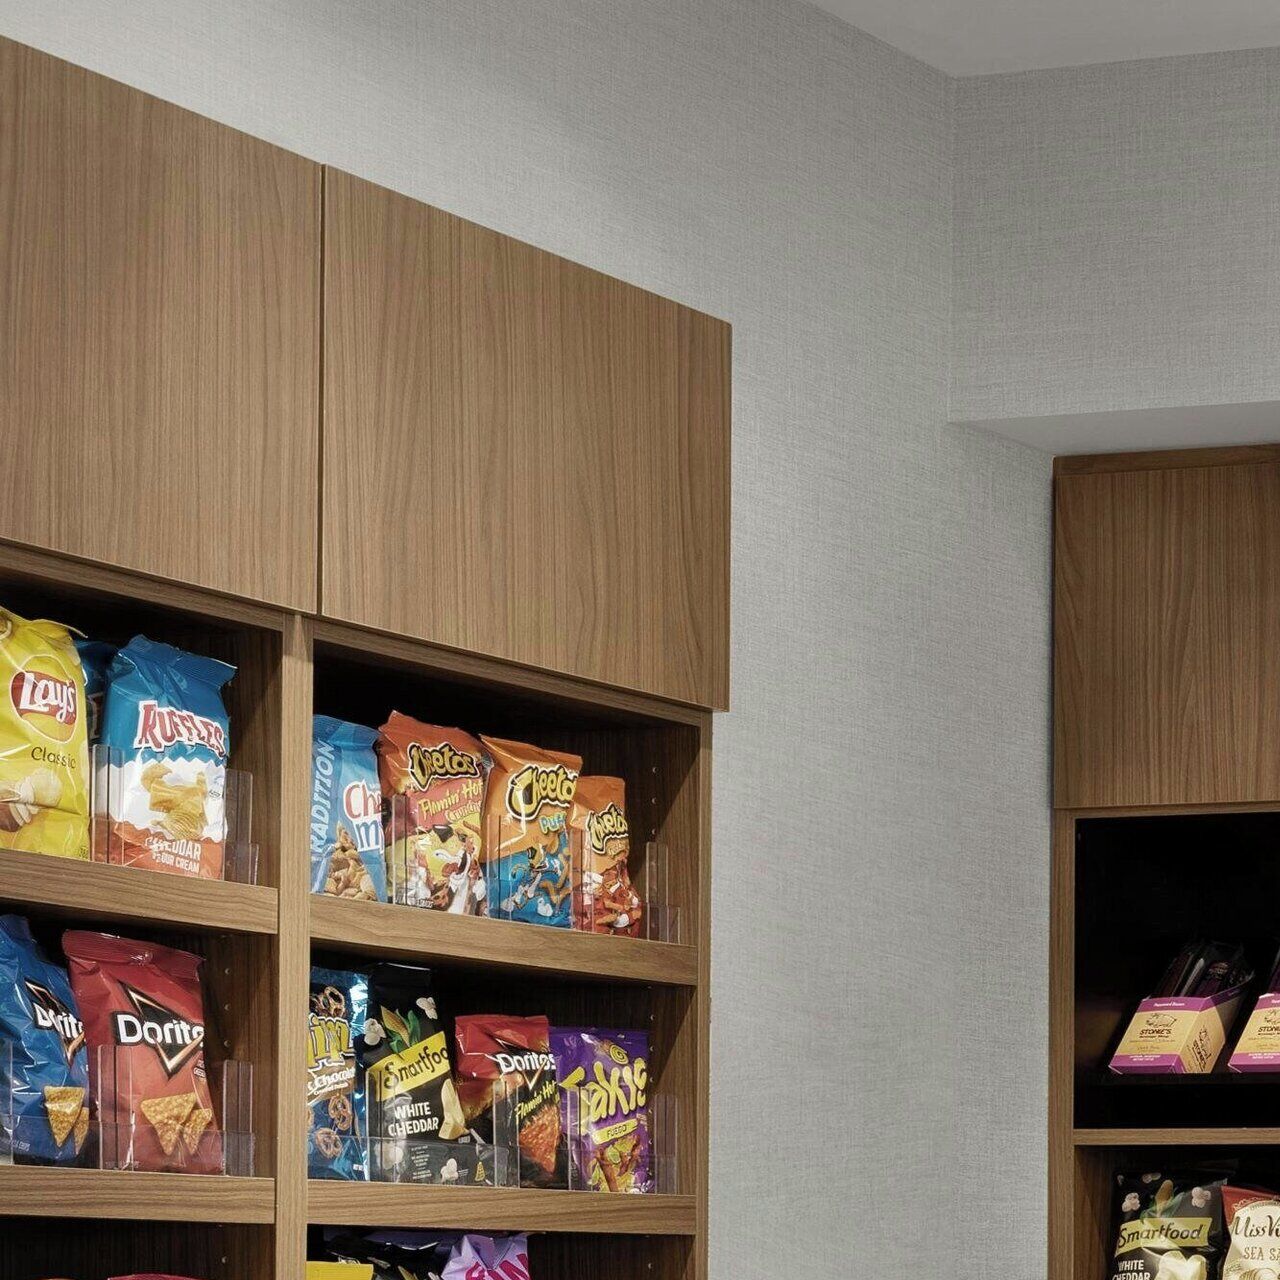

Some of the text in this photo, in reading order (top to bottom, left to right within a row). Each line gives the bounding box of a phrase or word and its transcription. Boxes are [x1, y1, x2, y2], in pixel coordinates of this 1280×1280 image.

[20, 672, 75, 723] Lay's
[134, 700, 227, 759] RUFFLES
[31, 746, 76, 769] Classic
[408, 743, 479, 791] Cheetos
[497, 1051, 557, 1074] Doritos
[394, 1101, 432, 1120] WHITE
[388, 1119, 440, 1137] CHEDDAR
[606, 1125, 629, 1138] FUEGO
[1118, 1221, 1204, 1248] Smartfood
[1231, 1216, 1265, 1239] Miss
[1118, 1259, 1144, 1272] WHITE
[1243, 1247, 1264, 1262] SEA
